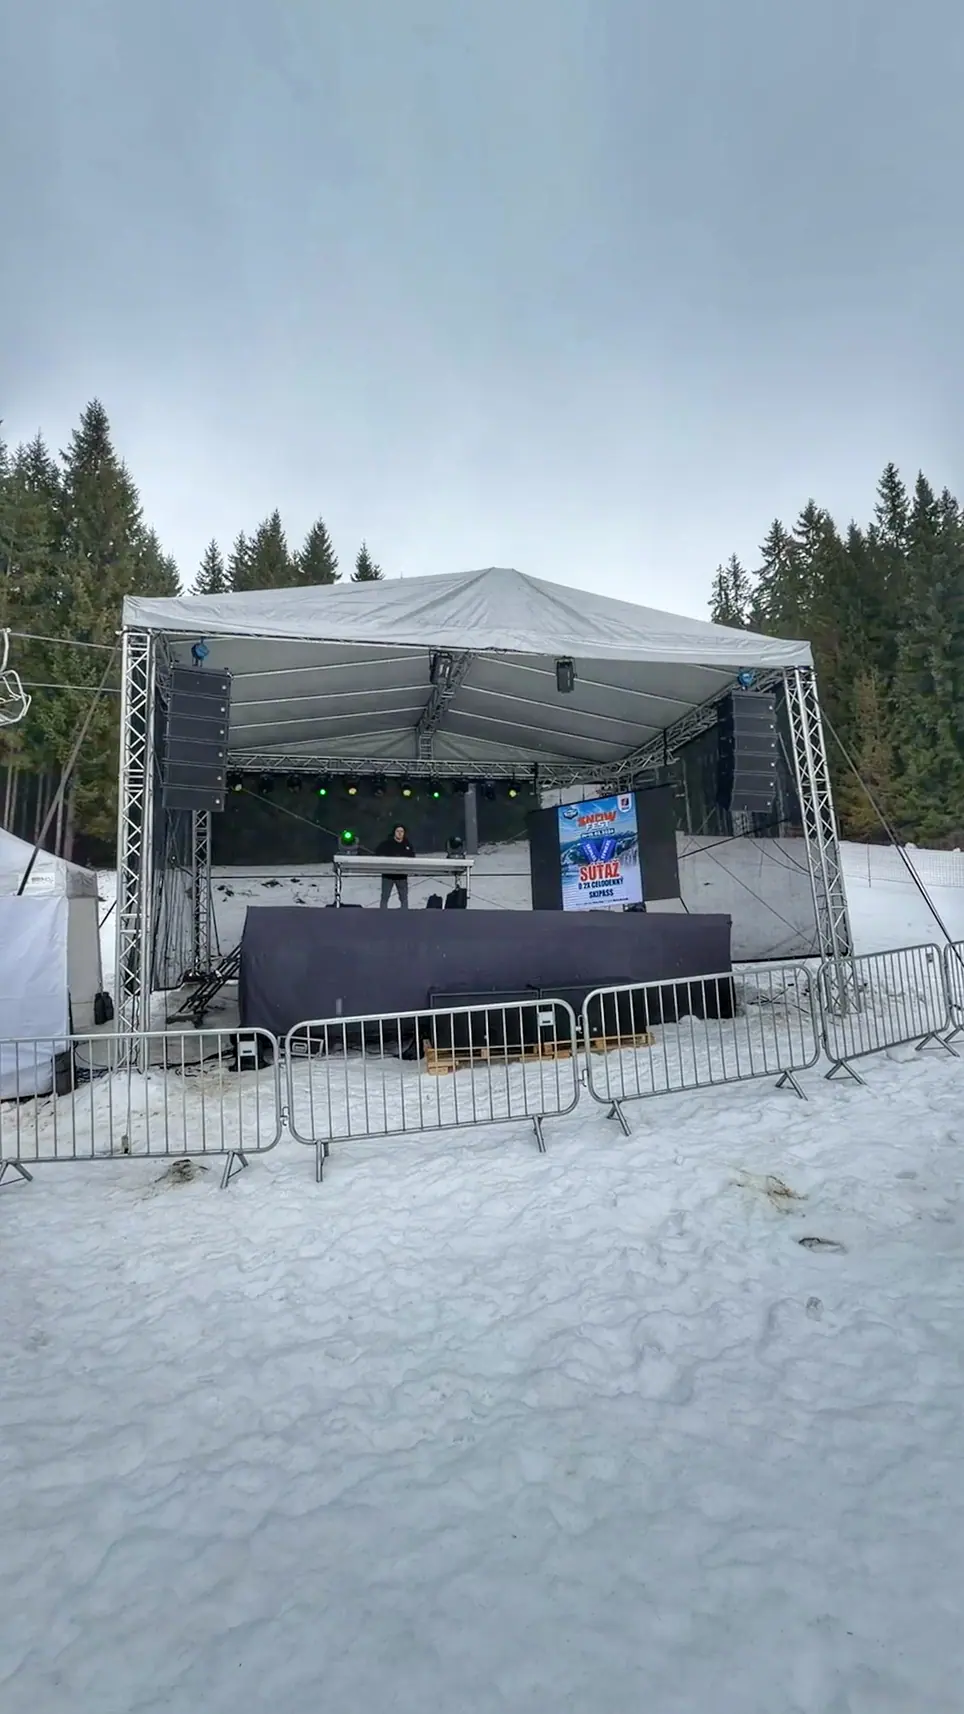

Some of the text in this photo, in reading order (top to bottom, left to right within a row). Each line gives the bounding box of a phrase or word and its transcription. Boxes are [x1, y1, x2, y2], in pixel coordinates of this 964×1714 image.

[577, 811, 616, 827] SNOW
[586, 820, 610, 831] FEST
[589, 889, 614, 898] SKIPASS
